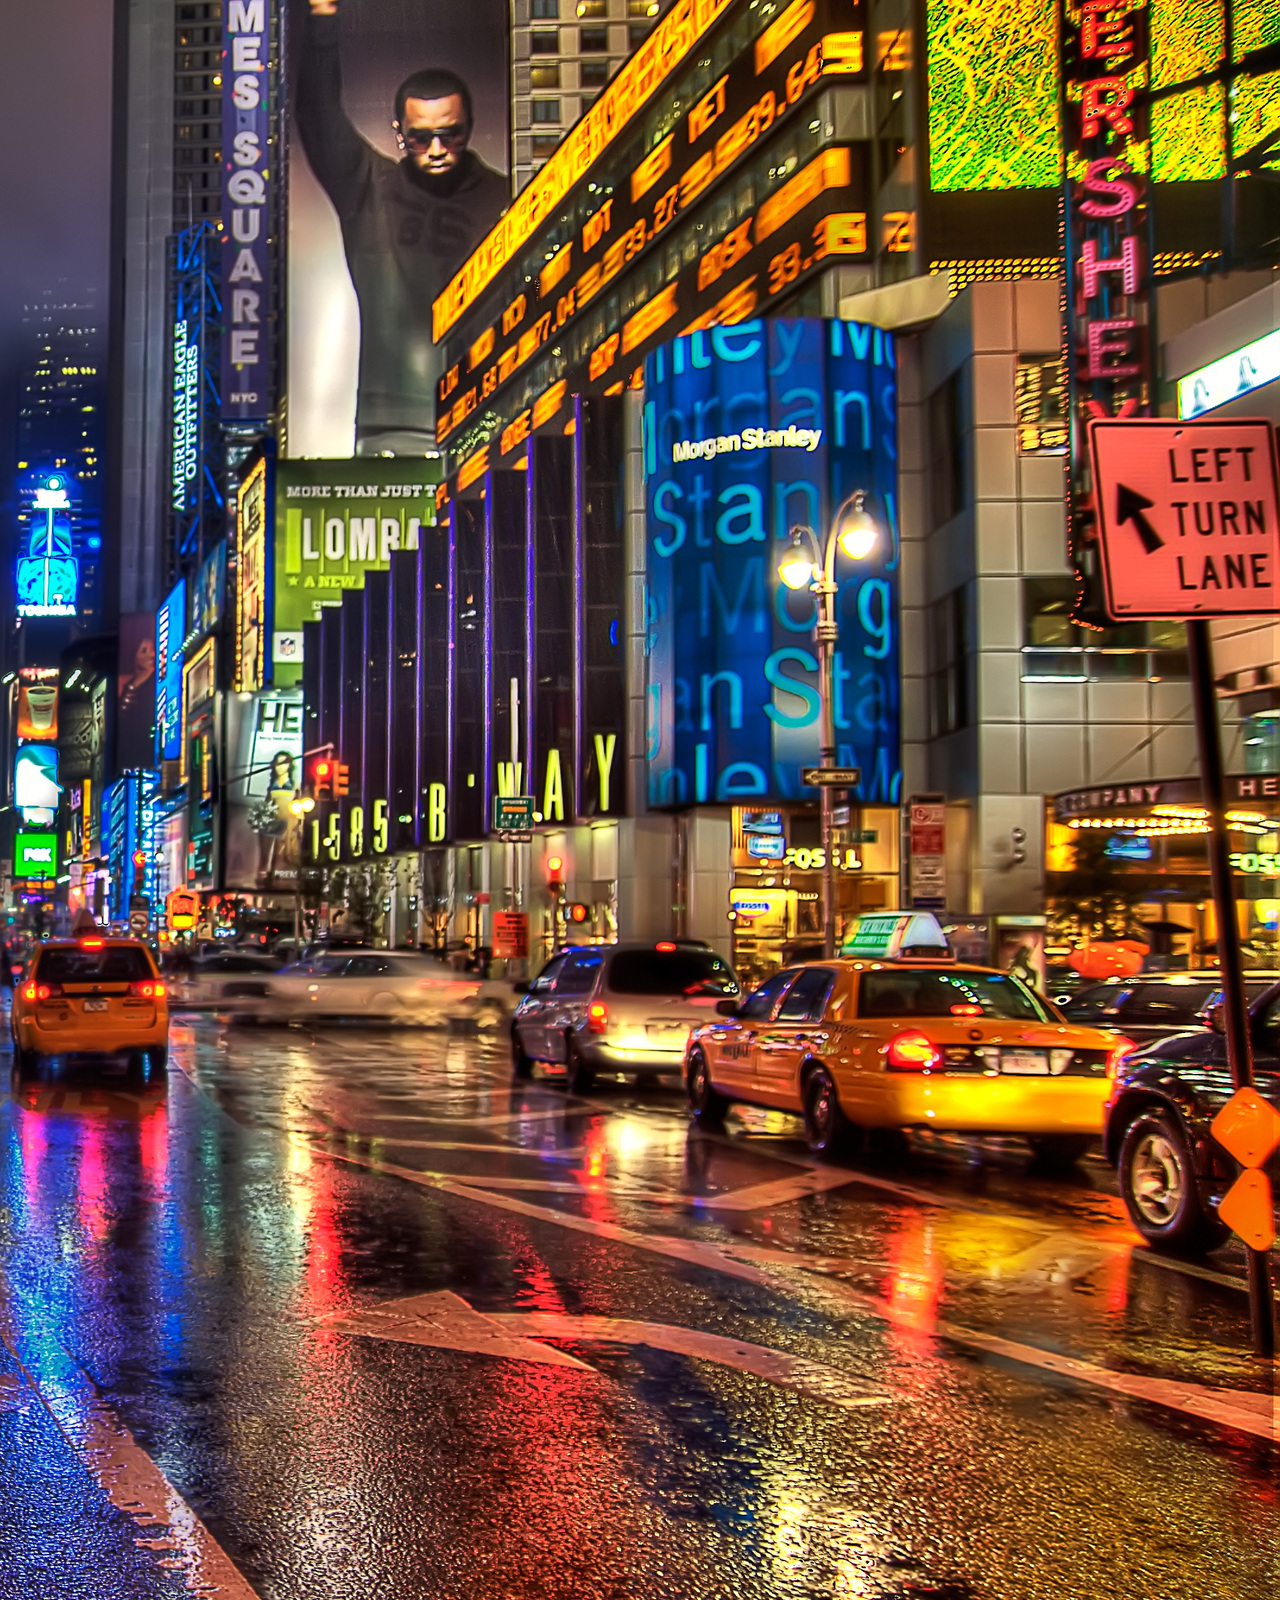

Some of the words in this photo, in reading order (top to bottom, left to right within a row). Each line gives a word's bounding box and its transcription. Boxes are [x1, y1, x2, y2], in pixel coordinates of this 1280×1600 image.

[228, 130, 266, 364] SQUARE
[174, 319, 188, 391] EAGLE
[185, 344, 199, 481] OUTFITTERS
[230, 392, 257, 404] NYC
[173, 393, 187, 511] AMERICAN
[673, 432, 741, 463] Morgan
[740, 425, 822, 452] Stanley
[1169, 446, 1256, 483] LEFT
[286, 485, 332, 498] MORE
[335, 485, 379, 498] THAN
[380, 485, 423, 498] JUST
[1170, 500, 1267, 537] TURN
[303, 575, 316, 588] A
[317, 575, 356, 588] NEW
[1177, 553, 1272, 590] LANE
[311, 799, 388, 862] 1585
